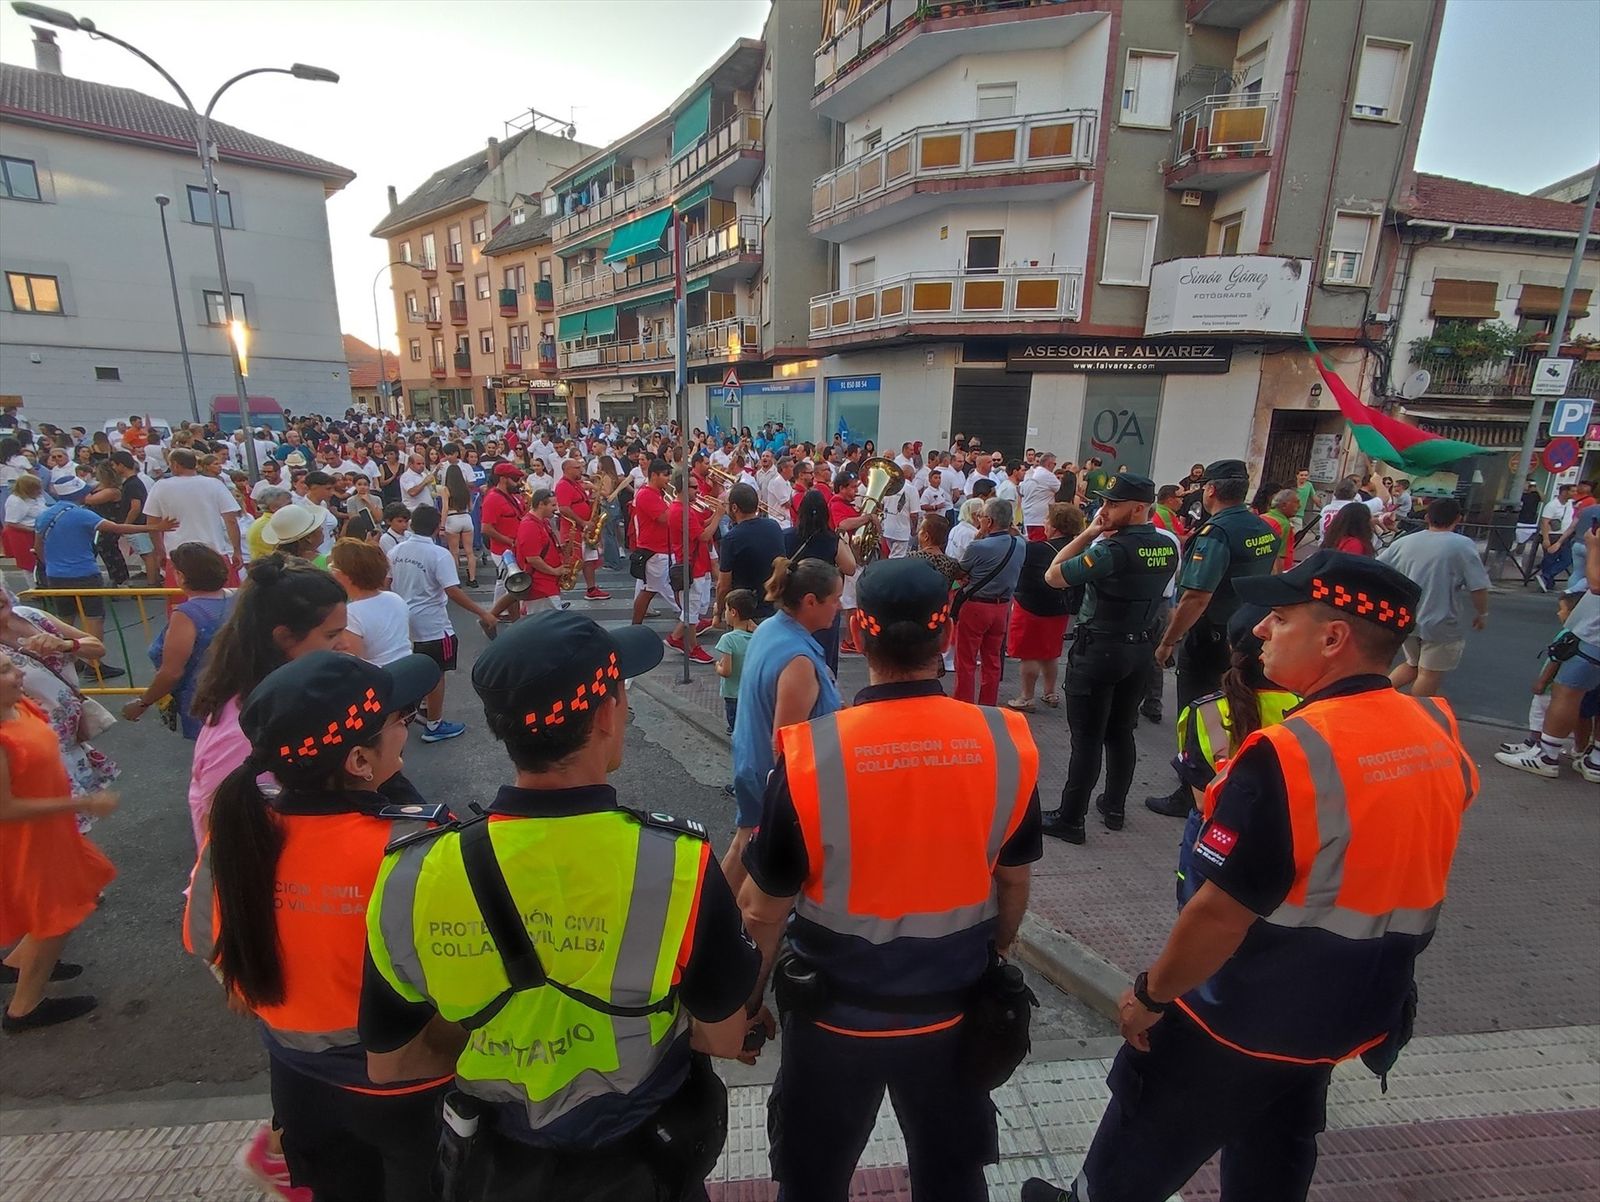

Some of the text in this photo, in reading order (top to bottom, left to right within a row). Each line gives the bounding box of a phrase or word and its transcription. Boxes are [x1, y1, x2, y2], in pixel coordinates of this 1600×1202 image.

[1179, 264, 1269, 291] Simón Gómez
[1193, 291, 1253, 300] FOTÓGRAFOS
[1023, 343, 1215, 357] ASESORÍA F. ALVAREZ
[1073, 362, 1156, 370] www.falvarez.com
[1557, 403, 1584, 433] P
[1245, 533, 1276, 548] GUARDIA
[1138, 547, 1174, 557] GUARDIA
[1255, 545, 1273, 556] CIVIL
[1147, 558, 1168, 567] CIVIL
[950, 738, 982, 750] CIVIL
[855, 752, 983, 774] COLLADO VILLALBA
[564, 915, 609, 935] CIVIL
